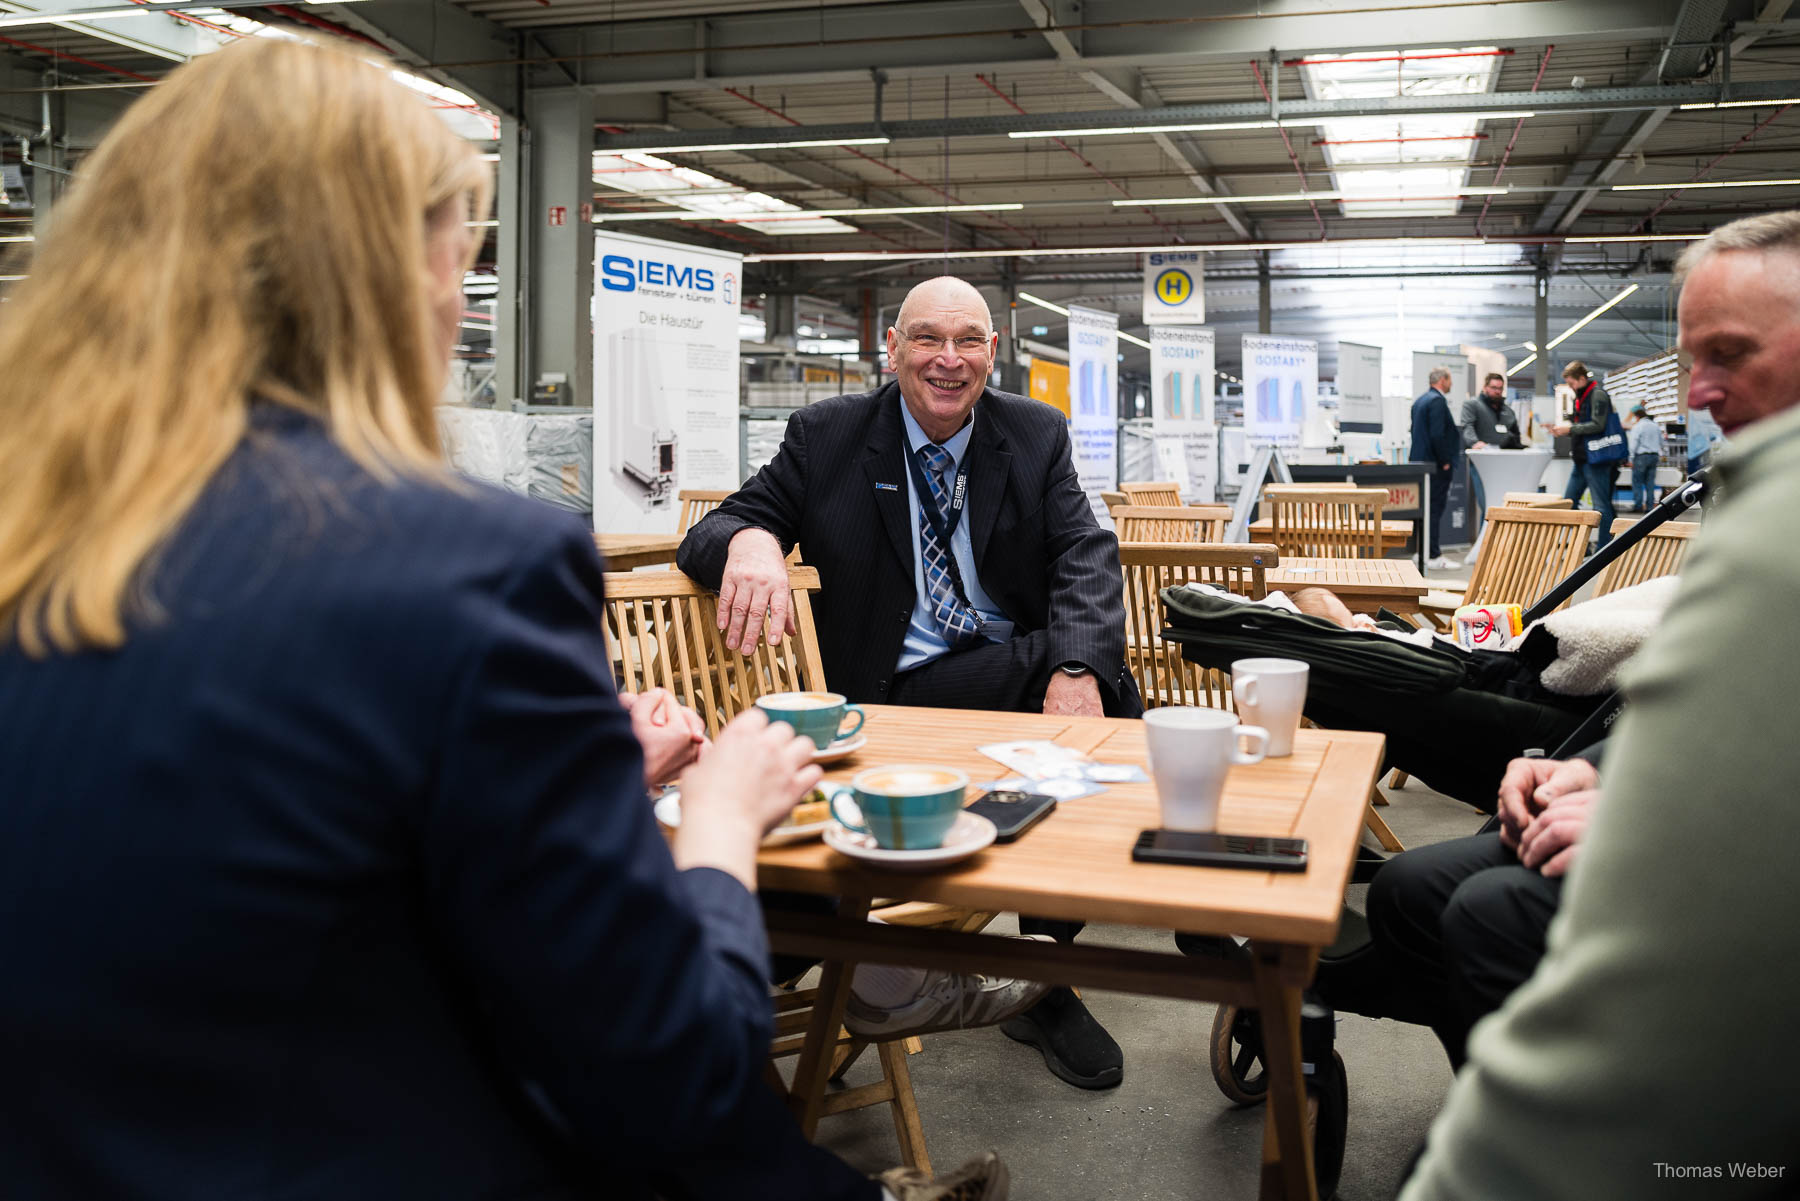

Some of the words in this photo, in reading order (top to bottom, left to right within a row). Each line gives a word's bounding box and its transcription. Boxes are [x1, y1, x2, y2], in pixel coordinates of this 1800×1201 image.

[602, 254, 714, 292] SIEMS
[1166, 278, 1181, 296] H
[640, 310, 656, 325] Die
[661, 314, 704, 330] Haustür
[953, 474, 964, 510] SIEMS
